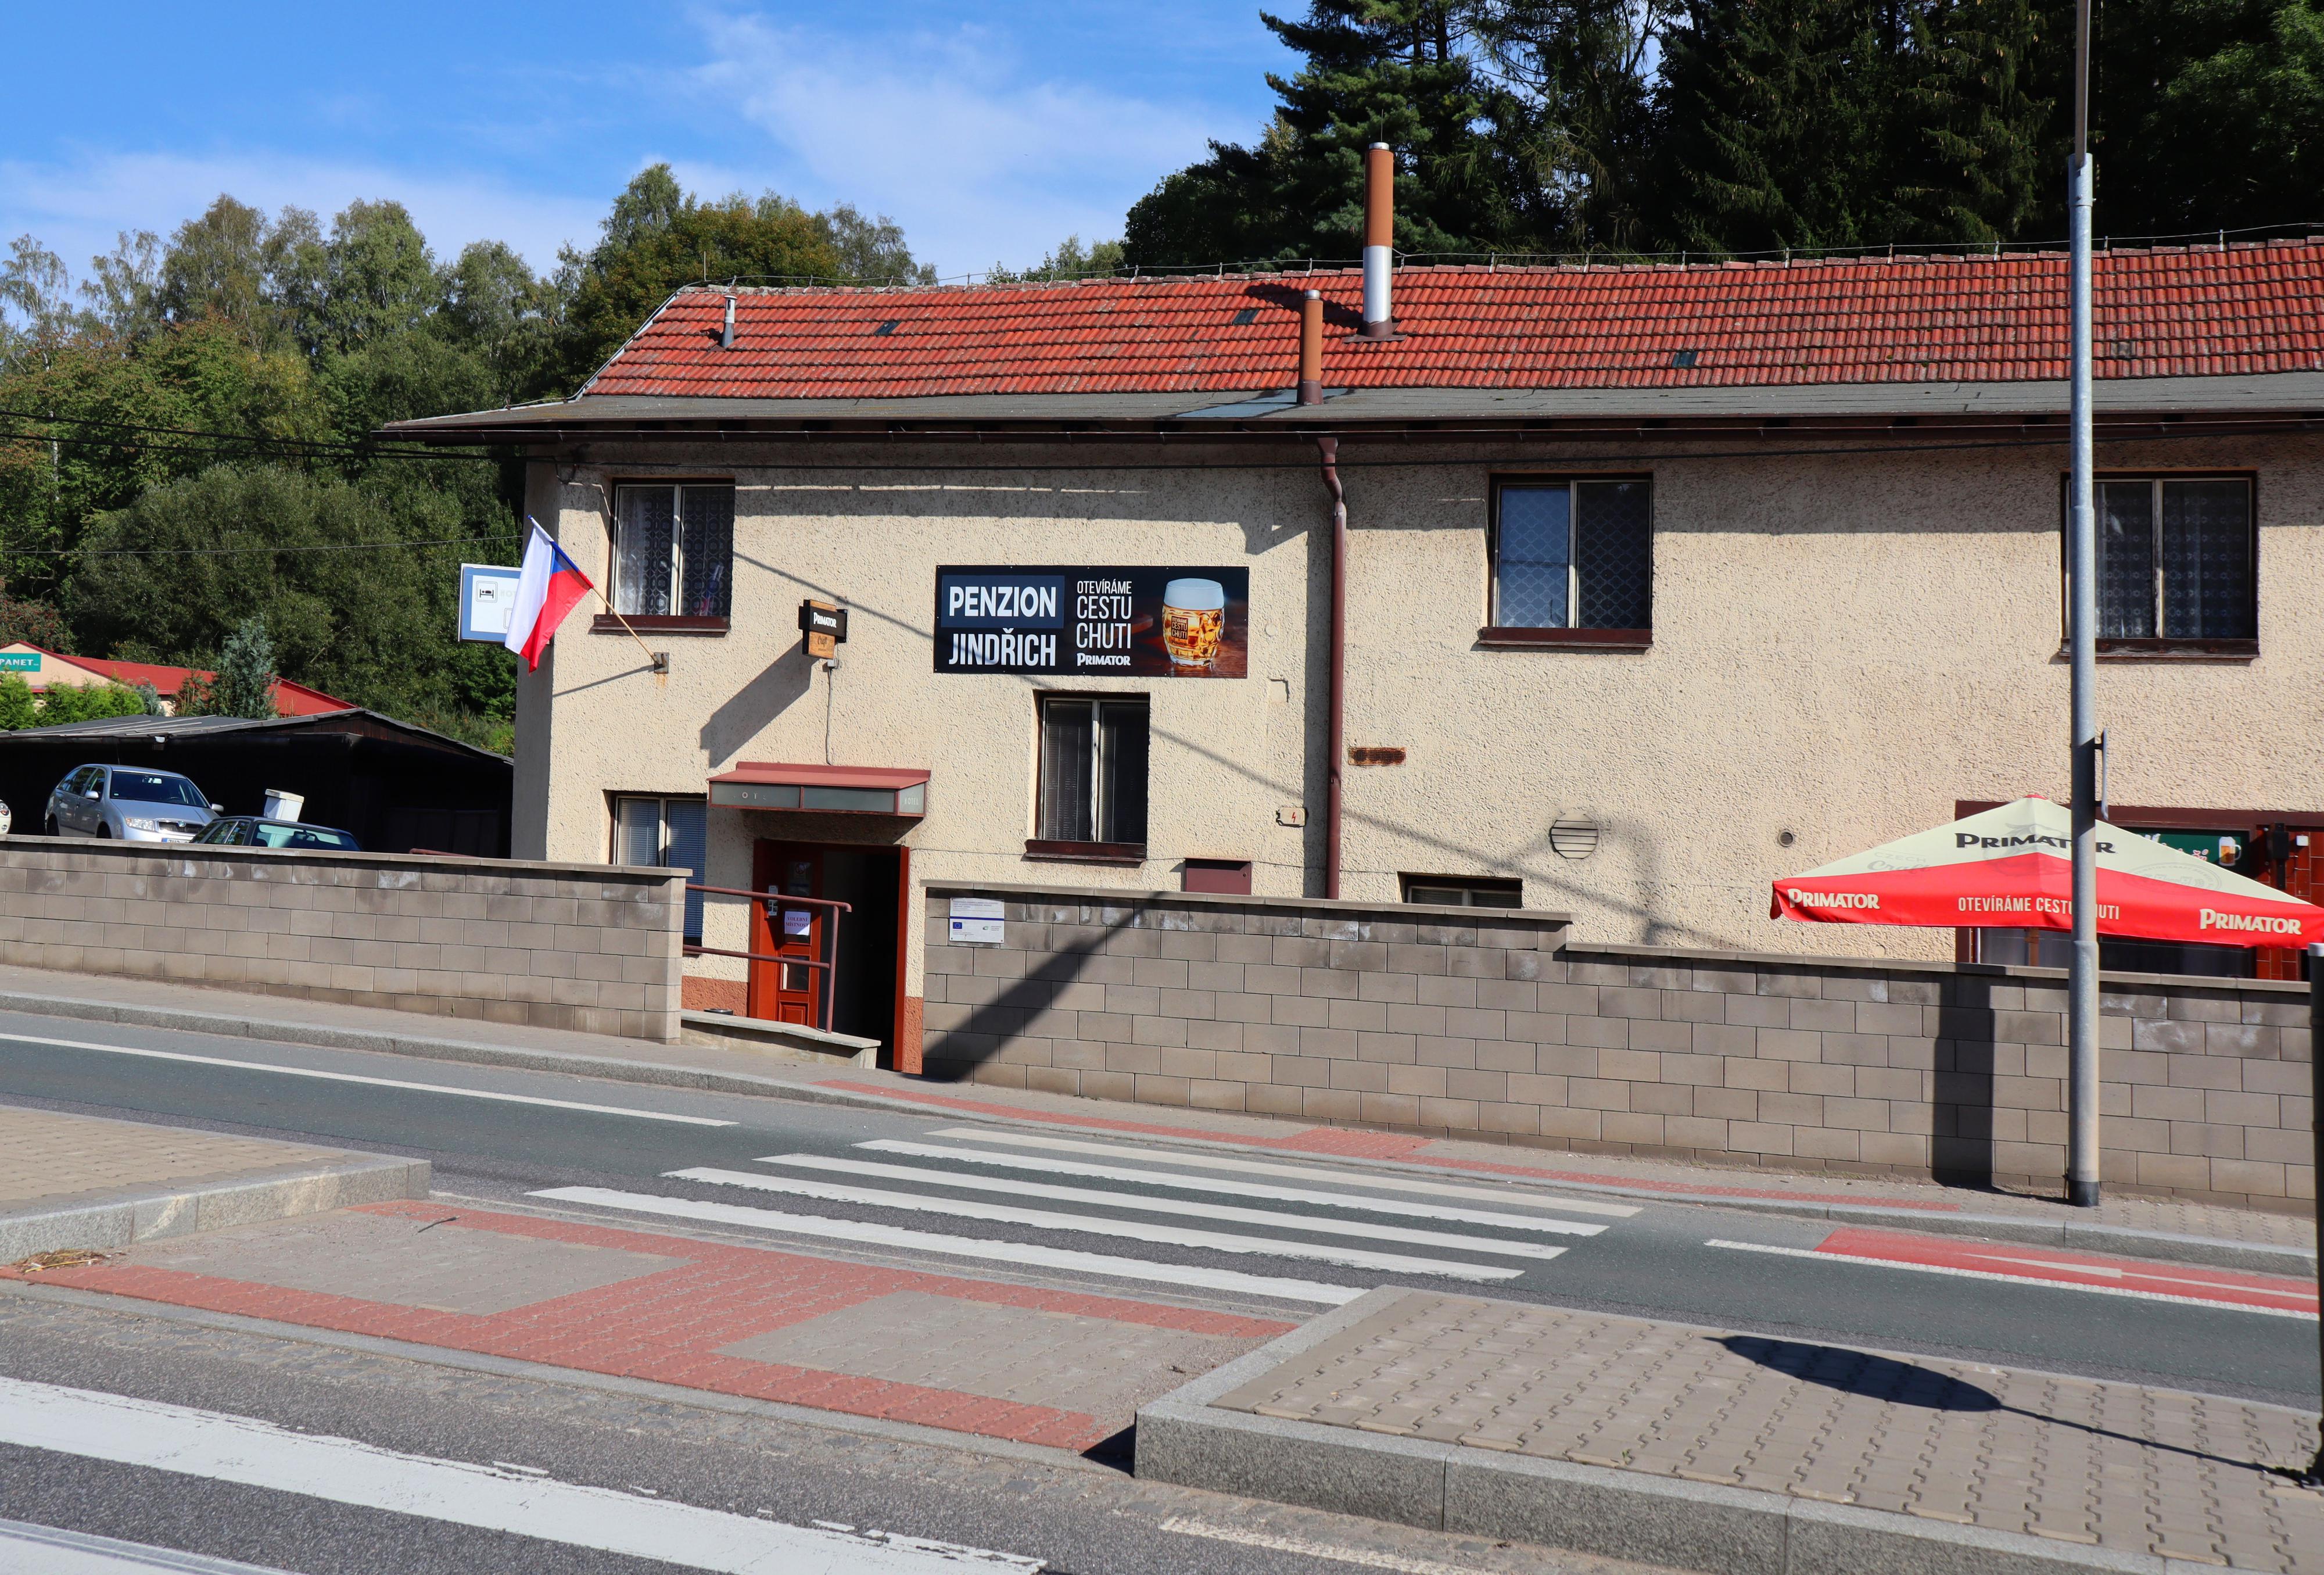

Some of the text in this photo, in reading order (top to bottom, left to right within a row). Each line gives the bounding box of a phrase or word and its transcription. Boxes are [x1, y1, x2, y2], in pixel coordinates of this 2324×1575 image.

[1077, 578, 1132, 594] OTEVÍRÁME
[949, 586, 1056, 617] PENZION
[1077, 595, 1132, 620] CESTU
[813, 612, 837, 628] PRIMATOR
[1171, 621, 1188, 631] CESTU
[1076, 622, 1131, 649] CHUTI
[1171, 629, 1187, 639] CHUTI
[948, 628, 1056, 667] JINDŘICH
[1077, 652, 1131, 667] PRIMATOR
[1955, 833, 2117, 854] PRIMATR
[1874, 851, 1927, 864] CZECH
[1787, 888, 1880, 910] PRIMATOR
[1958, 894, 2032, 912] OTEVÍRÁME
[2199, 908, 2303, 936] PRIMATOR
